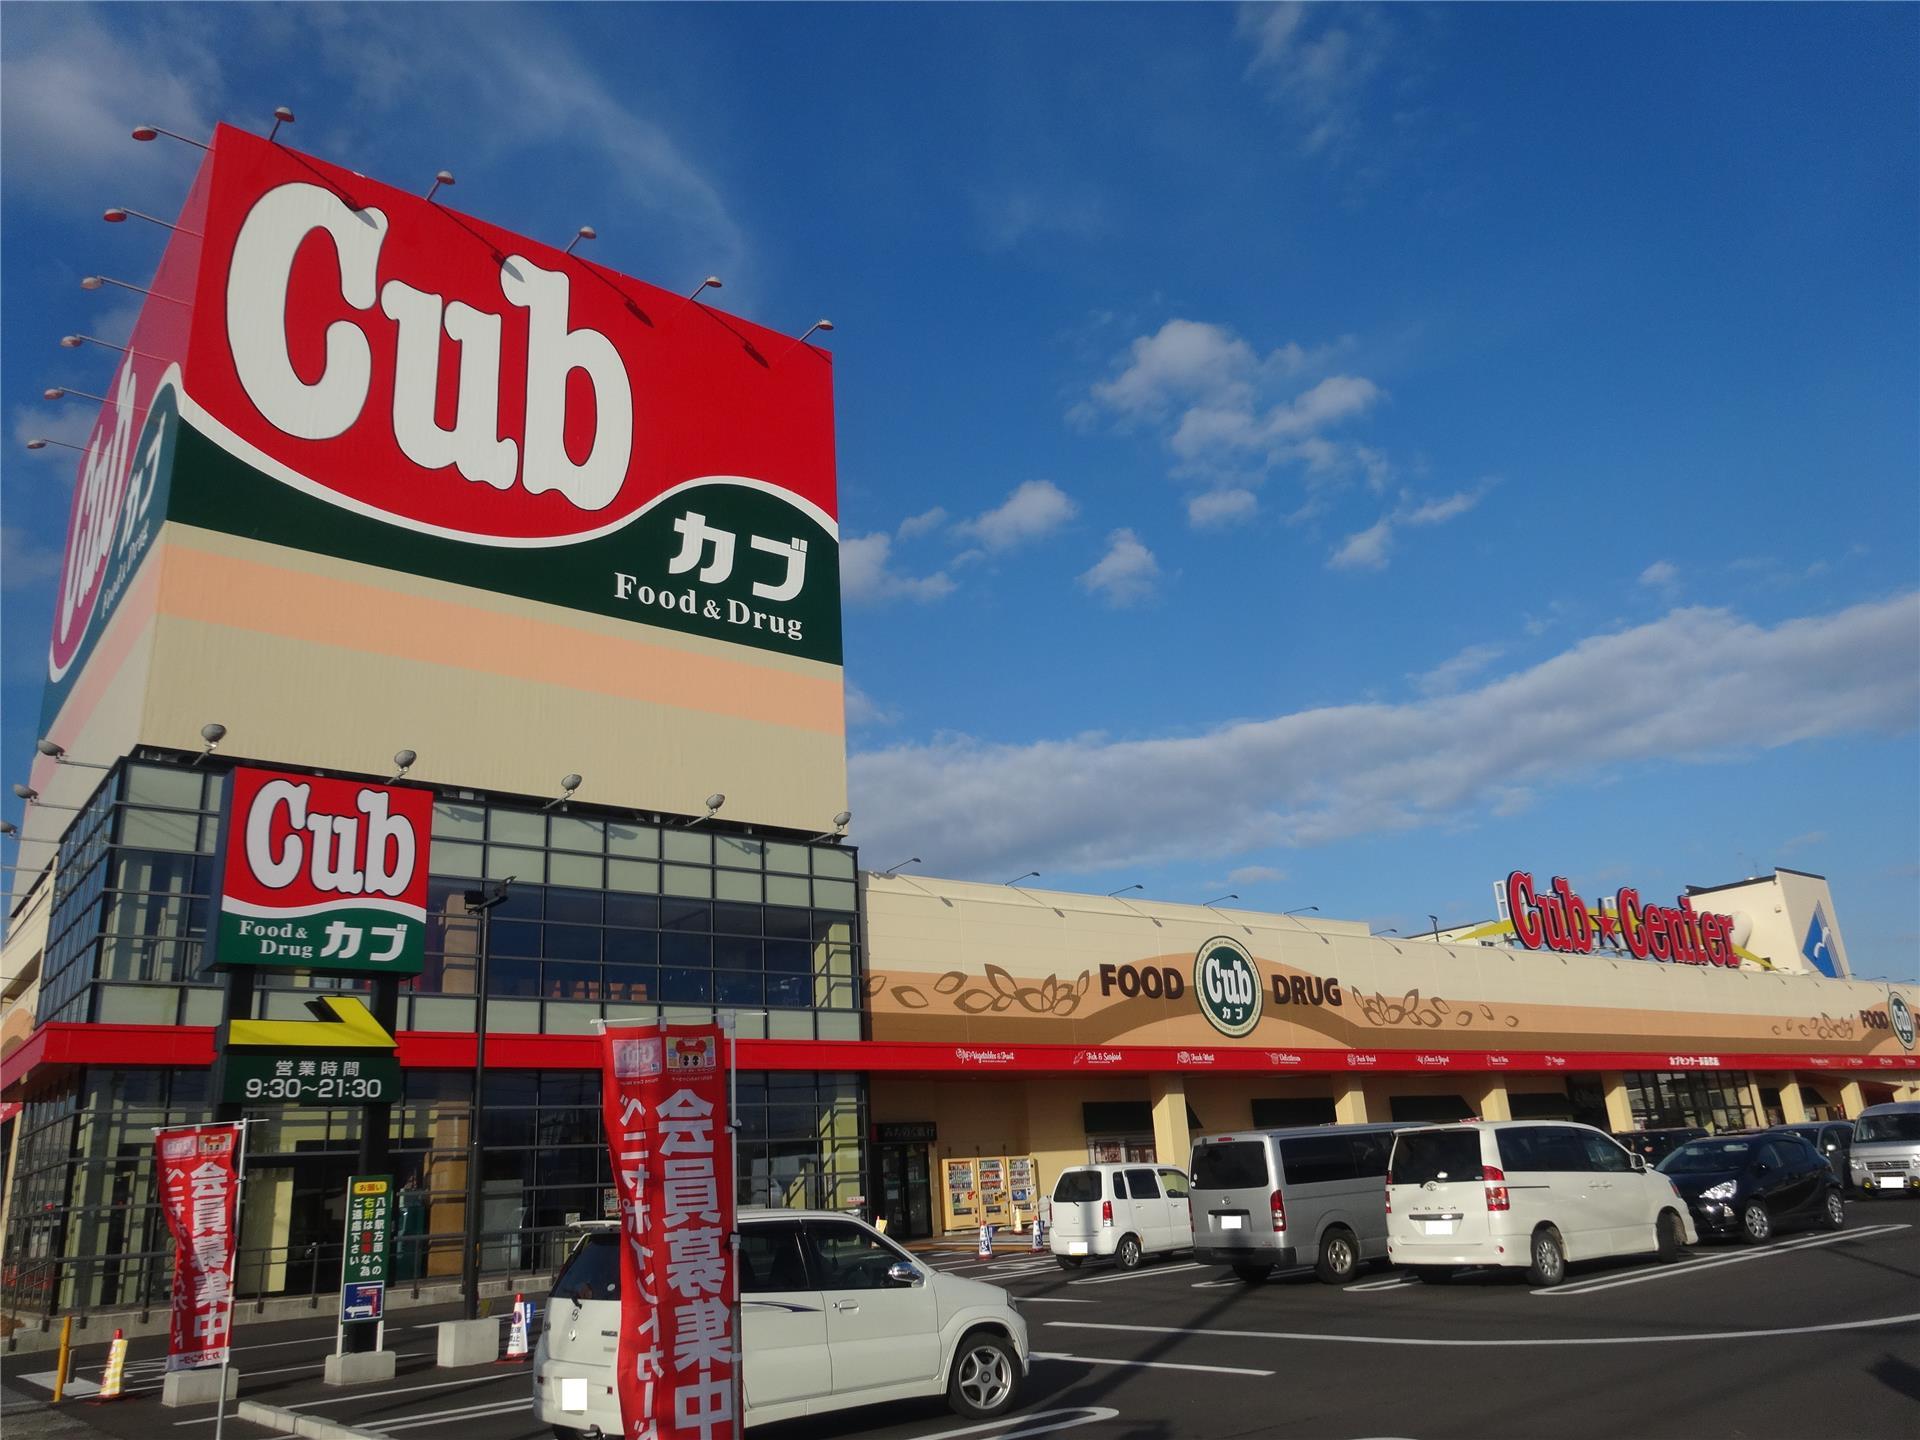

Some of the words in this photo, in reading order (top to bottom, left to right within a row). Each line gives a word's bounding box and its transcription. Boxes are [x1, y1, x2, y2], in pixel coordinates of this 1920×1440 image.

[226, 182, 634, 512] Cub
[668, 510, 808, 602] カブ
[613, 571, 698, 616] Food
[727, 598, 803, 641] Drug
[246, 779, 417, 897] Cub
[239, 920, 293, 938] Food
[320, 921, 408, 962] カブ
[1506, 870, 1595, 955] Cub
[1617, 887, 1741, 969] Center
[260, 939, 314, 958] Drug
[1099, 963, 1185, 1000] FOOD
[1205, 957, 1253, 1005] Cub
[1271, 974, 1343, 1007] DRUG
[1859, 1009, 1889, 1030] FOOD
[276, 1061, 360, 1077] 営業時間
[348, 1197, 364, 1266] ご遠慮下さい
[371, 1197, 387, 1276] 八戸駅方面への
